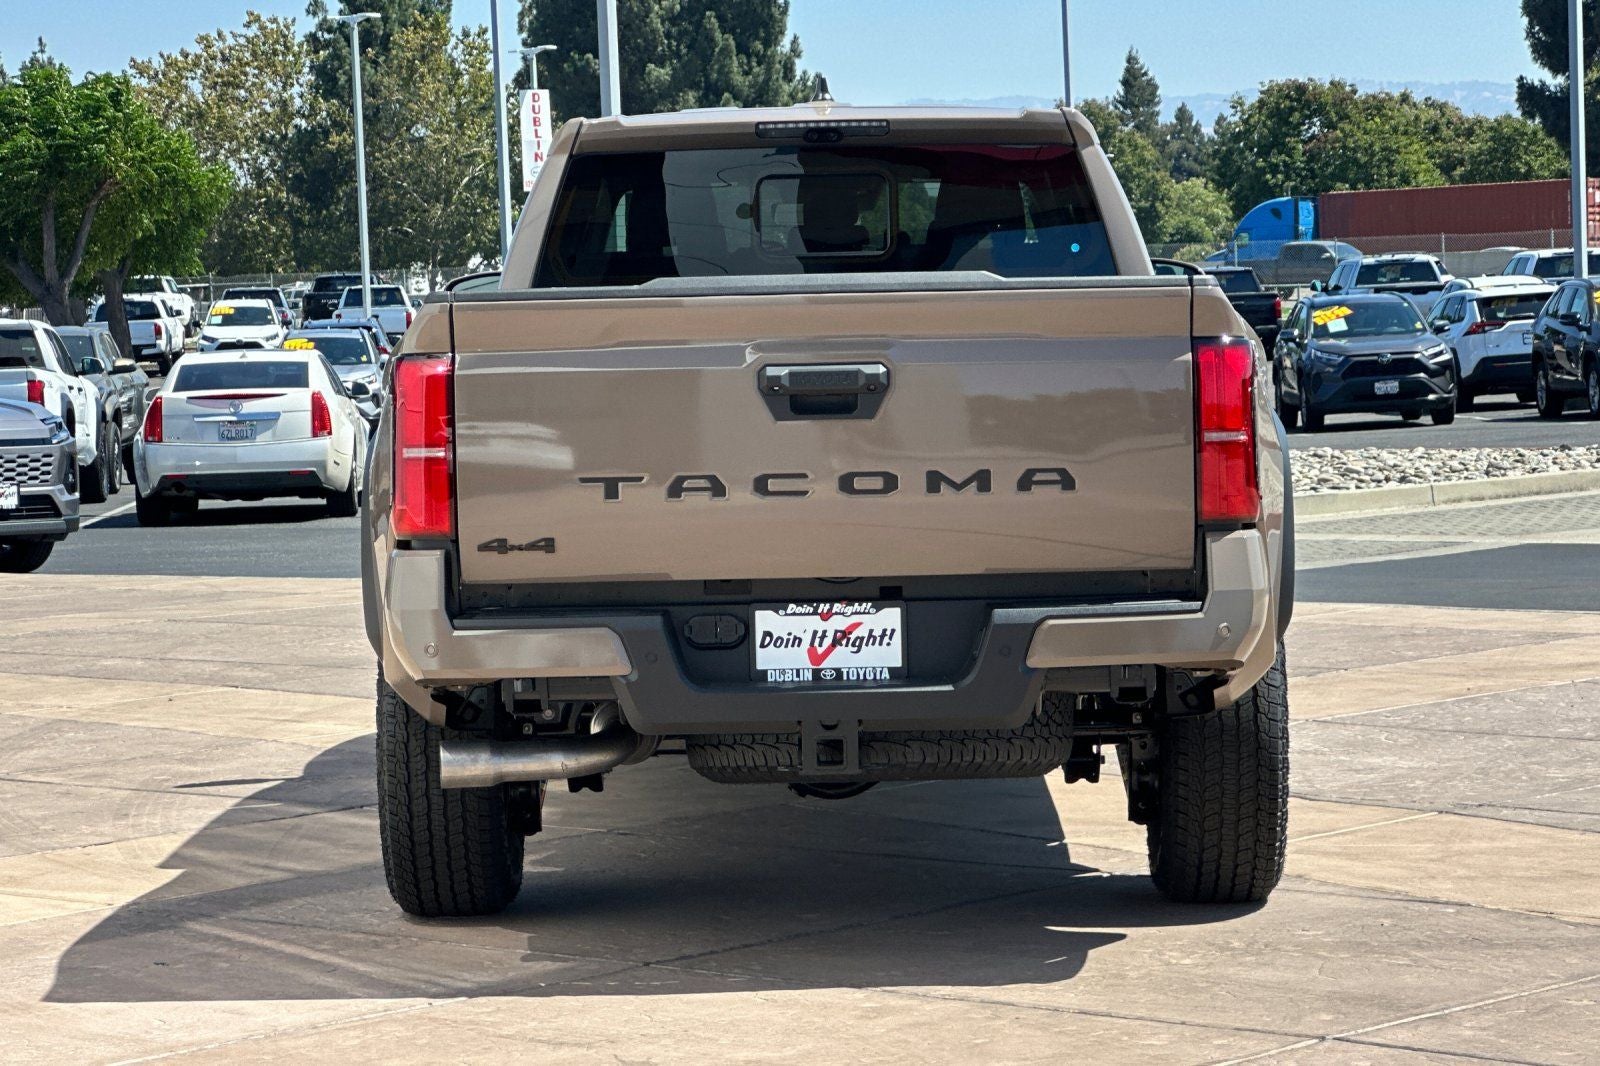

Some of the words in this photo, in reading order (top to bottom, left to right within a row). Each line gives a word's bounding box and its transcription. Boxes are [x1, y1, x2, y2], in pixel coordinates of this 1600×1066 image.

[532, 92, 544, 162] DUBLIN
[579, 468, 1077, 502] TACOMA
[477, 537, 555, 554] 4x4
[786, 603, 816, 614] Doin'
[818, 603, 831, 614] It
[832, 602, 870, 616] Right!
[759, 629, 806, 648] Doin'
[809, 629, 828, 647] It
[831, 628, 896, 653] Right!
[767, 669, 813, 682] DUBLIN
[841, 668, 890, 680] TOYOTA
